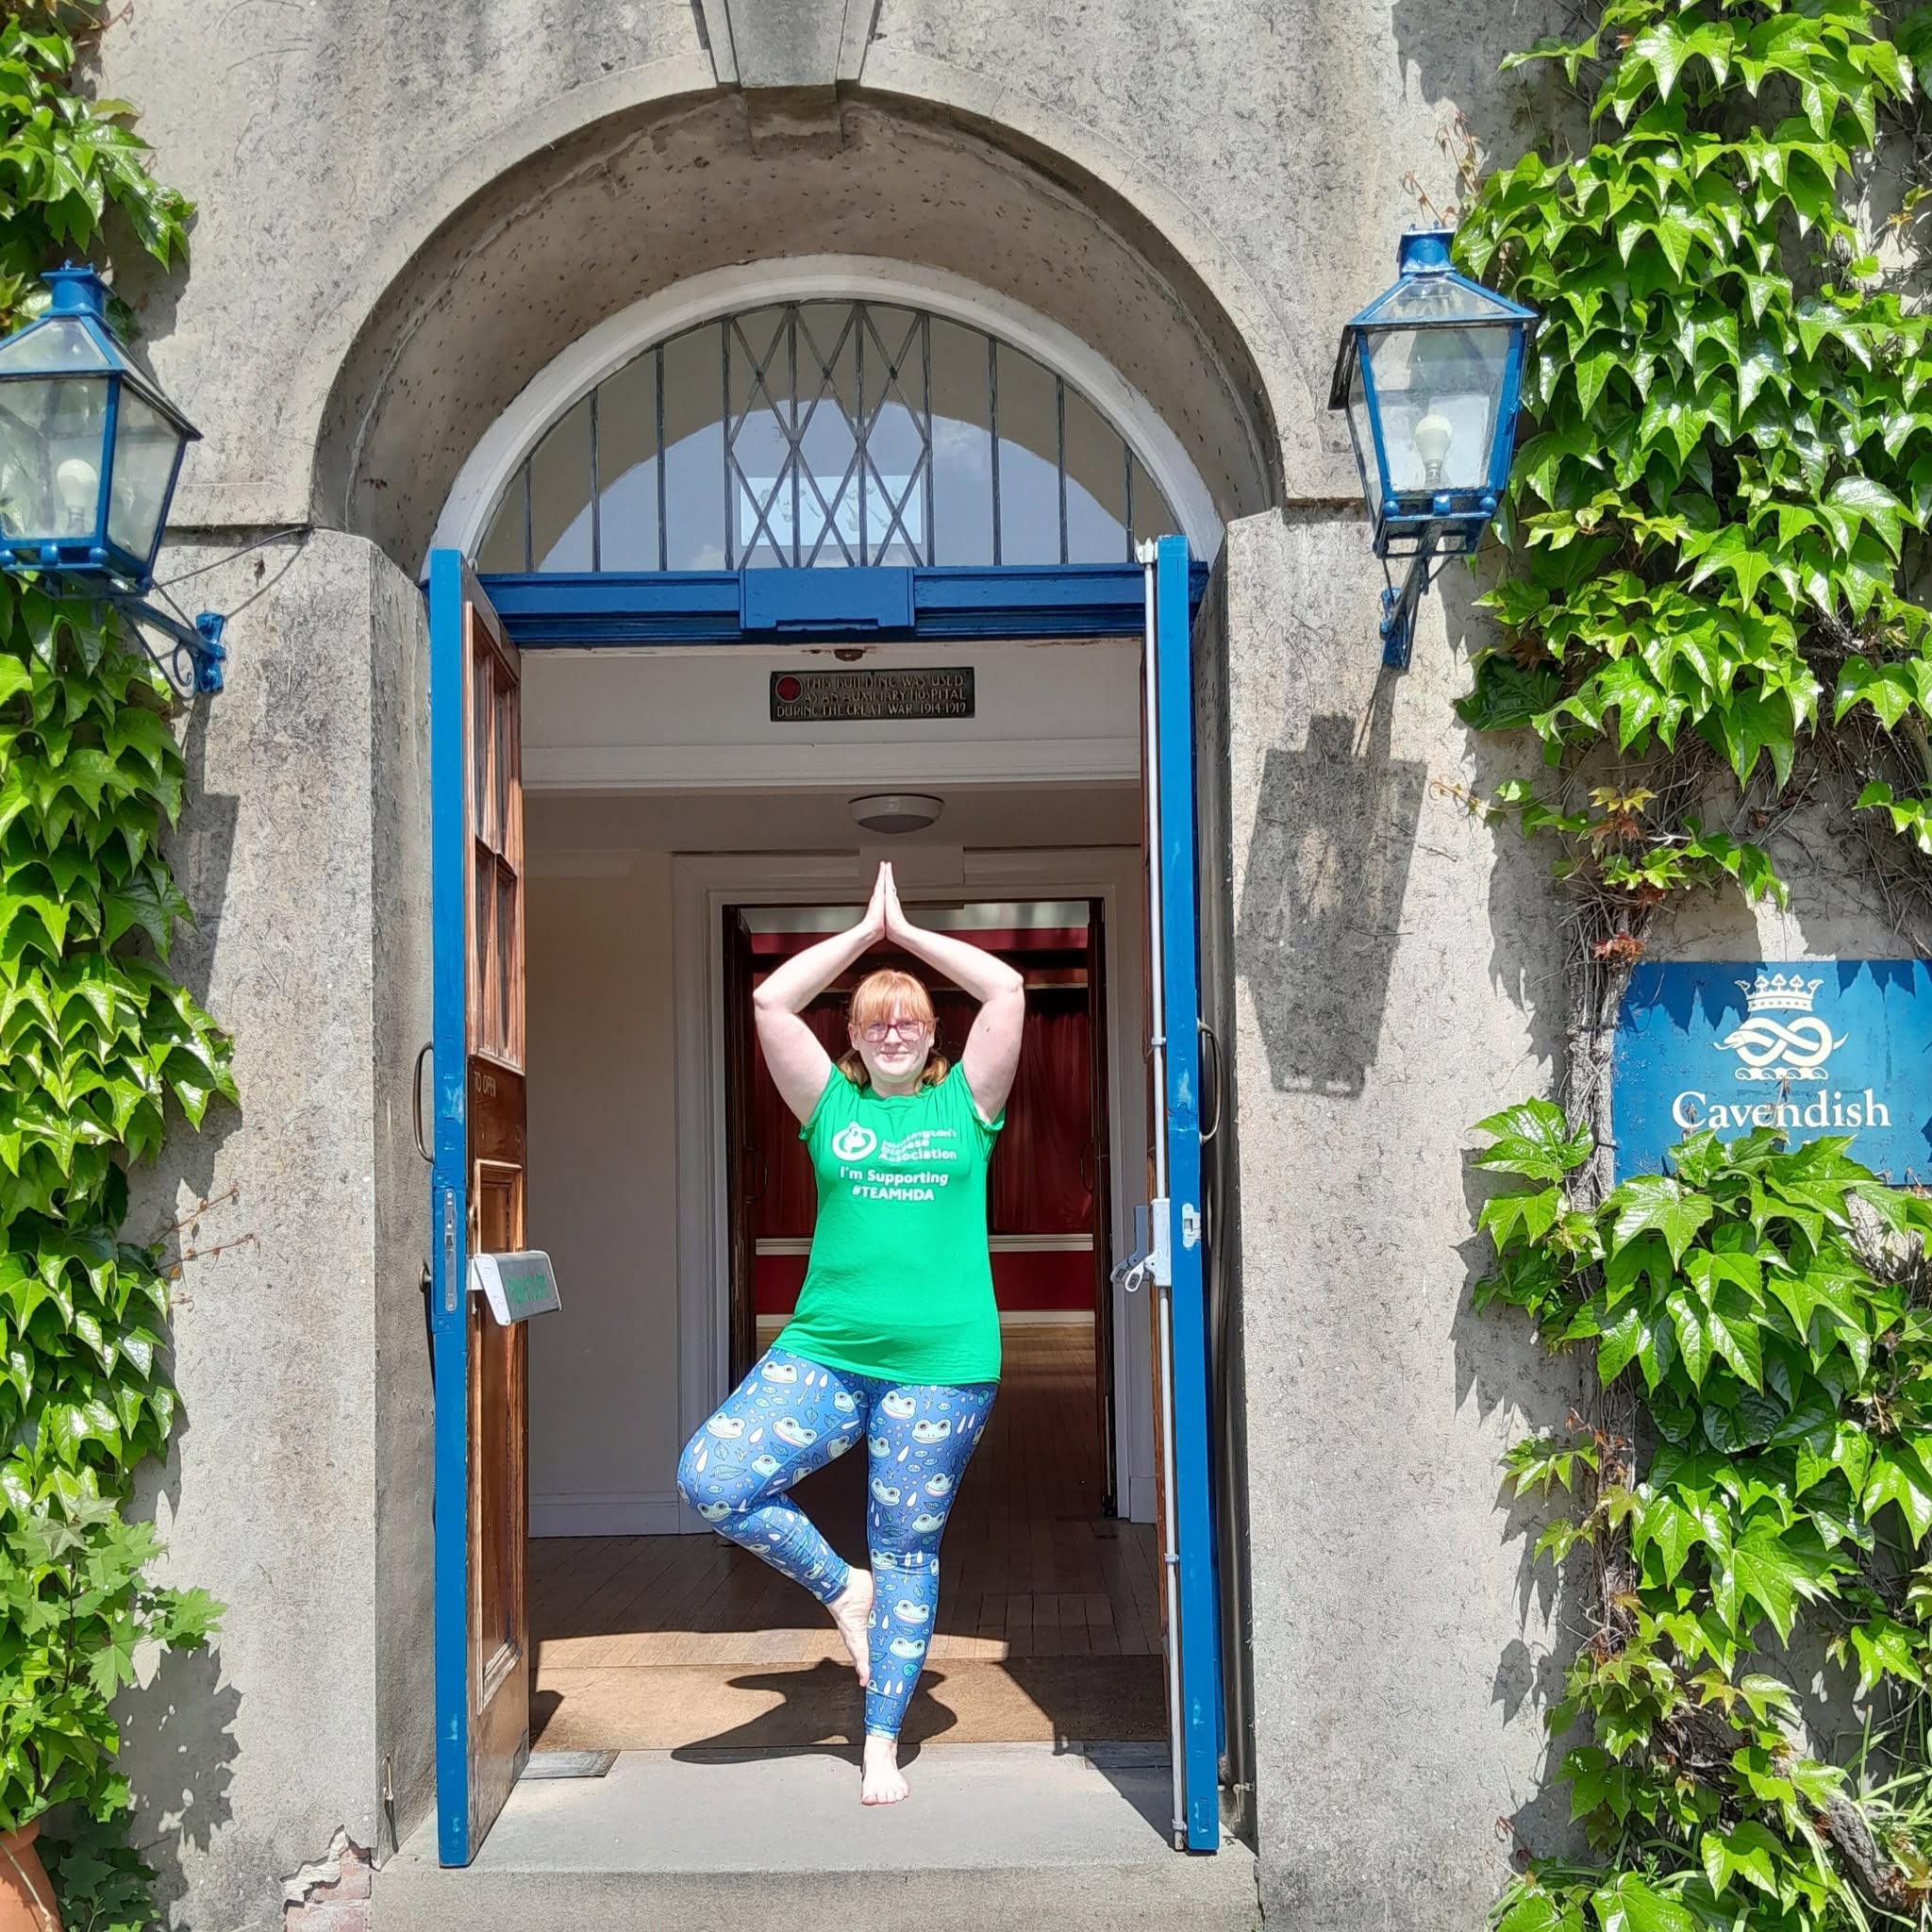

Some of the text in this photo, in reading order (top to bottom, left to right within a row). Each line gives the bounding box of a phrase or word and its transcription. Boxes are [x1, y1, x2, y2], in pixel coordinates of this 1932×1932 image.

[805, 675, 964, 690] THIS BUILDING WAS USED
[803, 688, 967, 704] AS AN AUXILIARY HOSPITAL
[776, 701, 967, 718] DURING THE GREAT WAR 1914-1919
[474, 1071, 497, 1098] TO OPEN
[1671, 1089, 1892, 1129] Cavendish
[840, 1166, 949, 1186] I'm Supporting
[852, 1185, 936, 1202] #TEAMHDA
